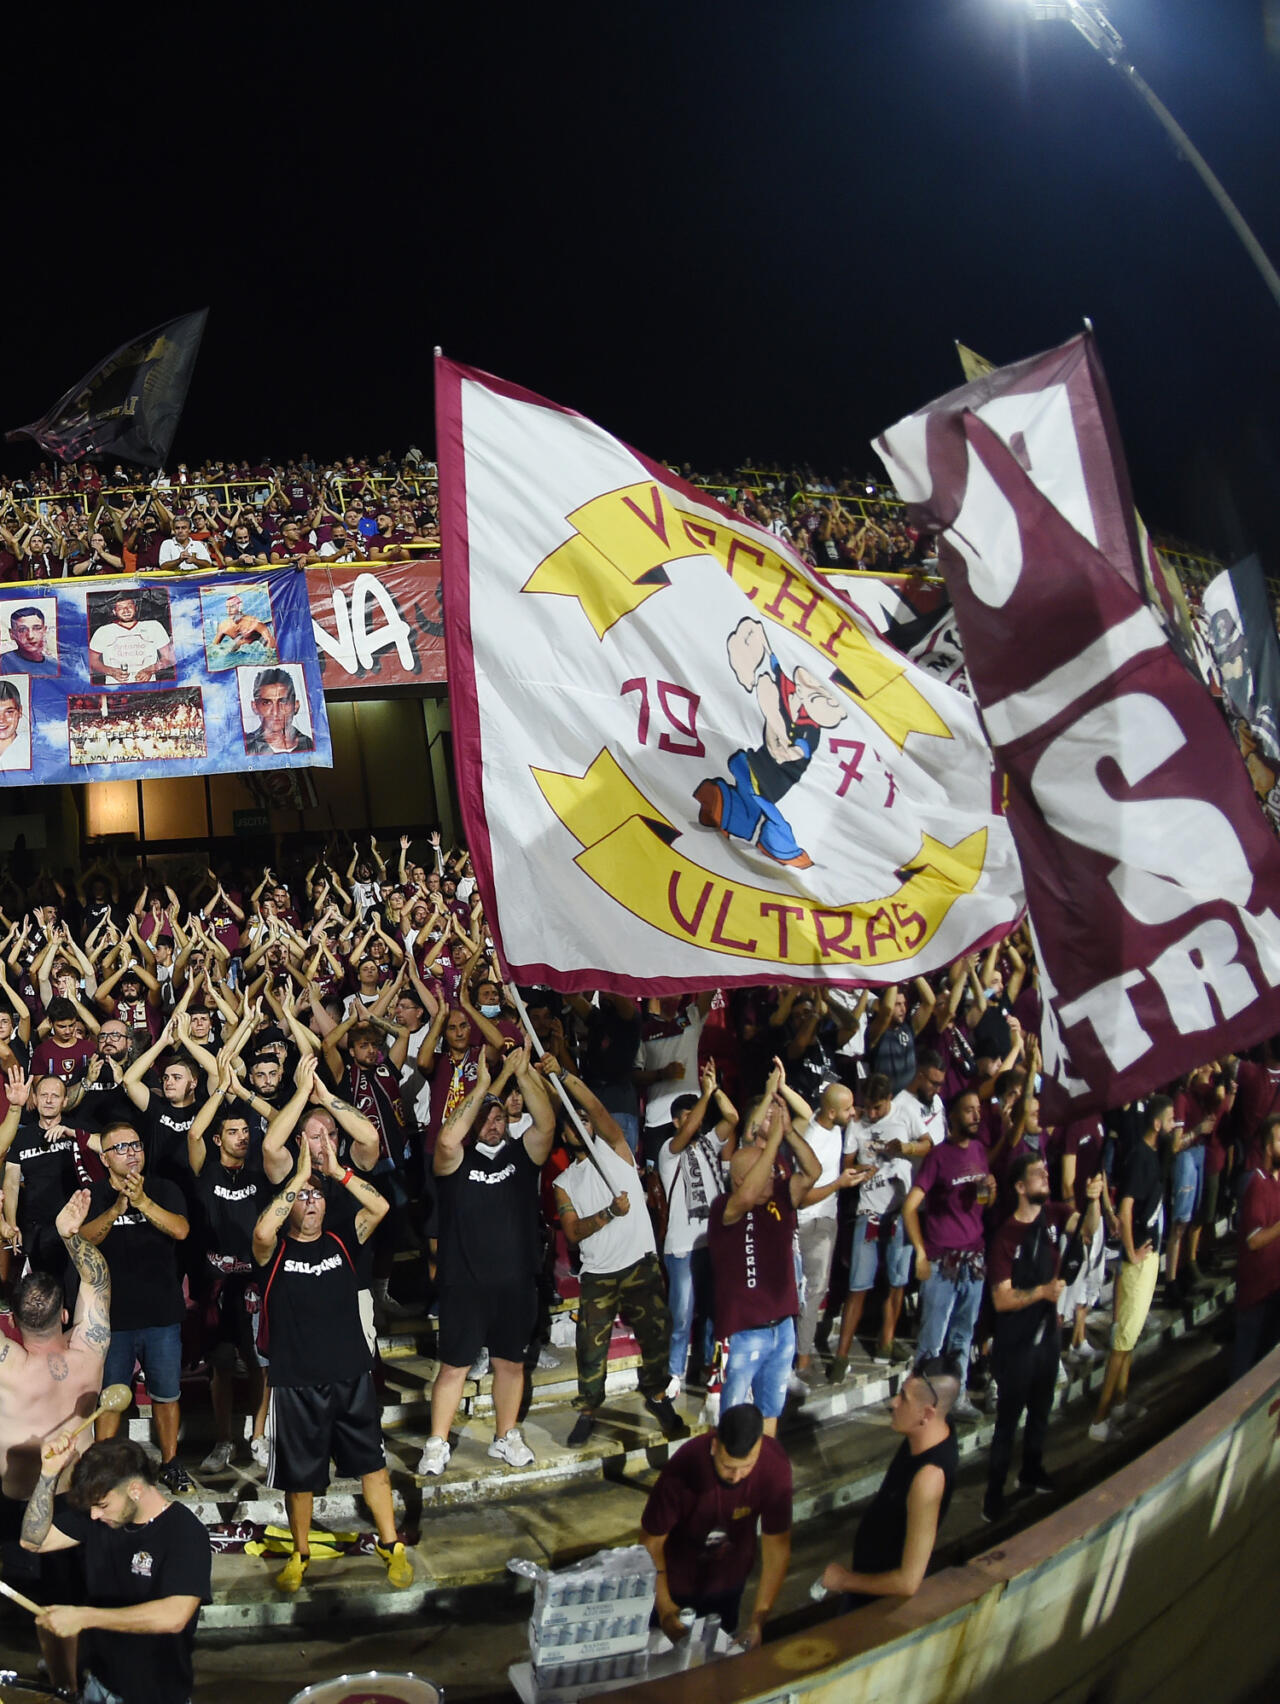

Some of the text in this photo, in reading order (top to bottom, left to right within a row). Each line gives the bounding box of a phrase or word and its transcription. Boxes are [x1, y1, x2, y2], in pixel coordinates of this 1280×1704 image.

[620, 677, 706, 758] 19
[668, 870, 928, 960] ULTRAS
[745, 1210, 757, 1289] SALERNO
